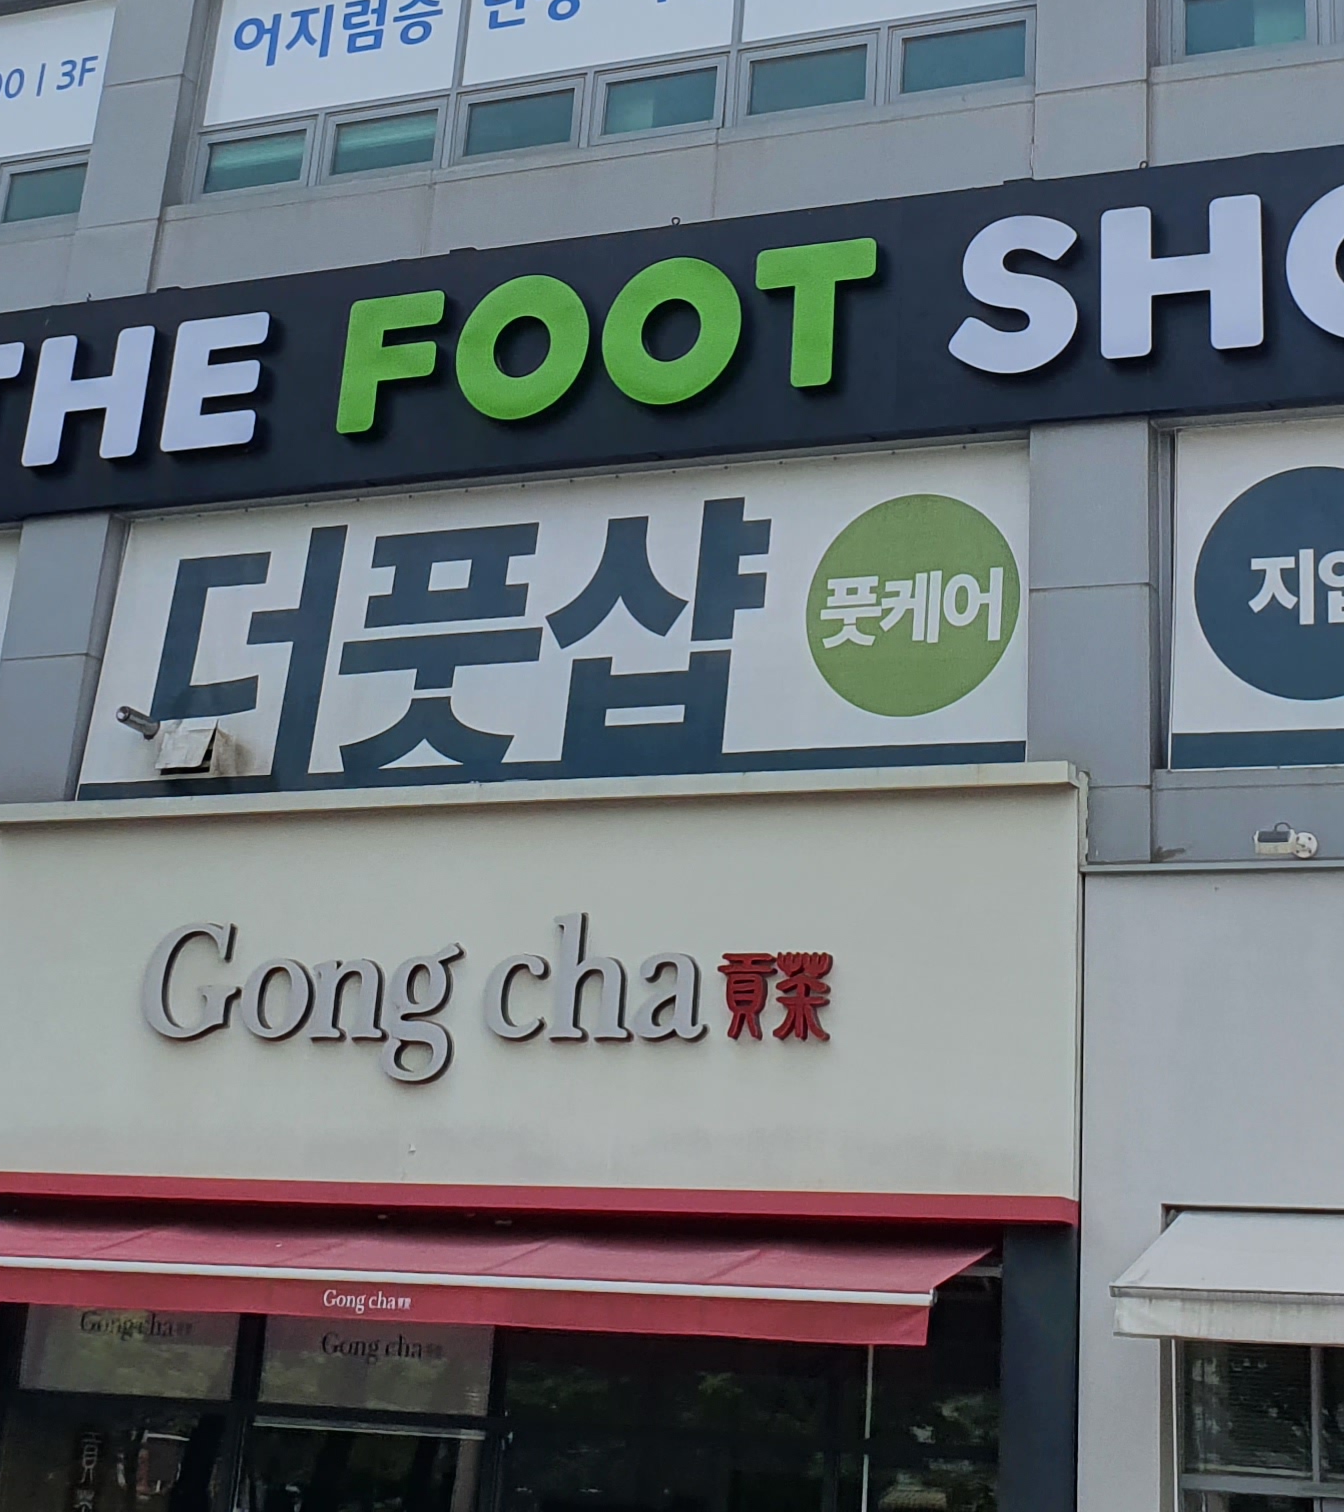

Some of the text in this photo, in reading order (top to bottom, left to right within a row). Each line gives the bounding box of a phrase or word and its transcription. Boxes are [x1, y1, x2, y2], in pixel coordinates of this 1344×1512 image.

[55, 54, 100, 92] 3F
[334, 236, 882, 438] FOOT
[151, 494, 774, 788] 더풋샵
[817, 559, 1008, 654] 풋케어
[142, 918, 467, 1086] Gong
[483, 910, 711, 1045] cha
[320, 1332, 380, 1365] Gong
[384, 1334, 423, 1359] cha
[323, 1289, 367, 1315] Gong
[368, 1290, 396, 1310] cha
